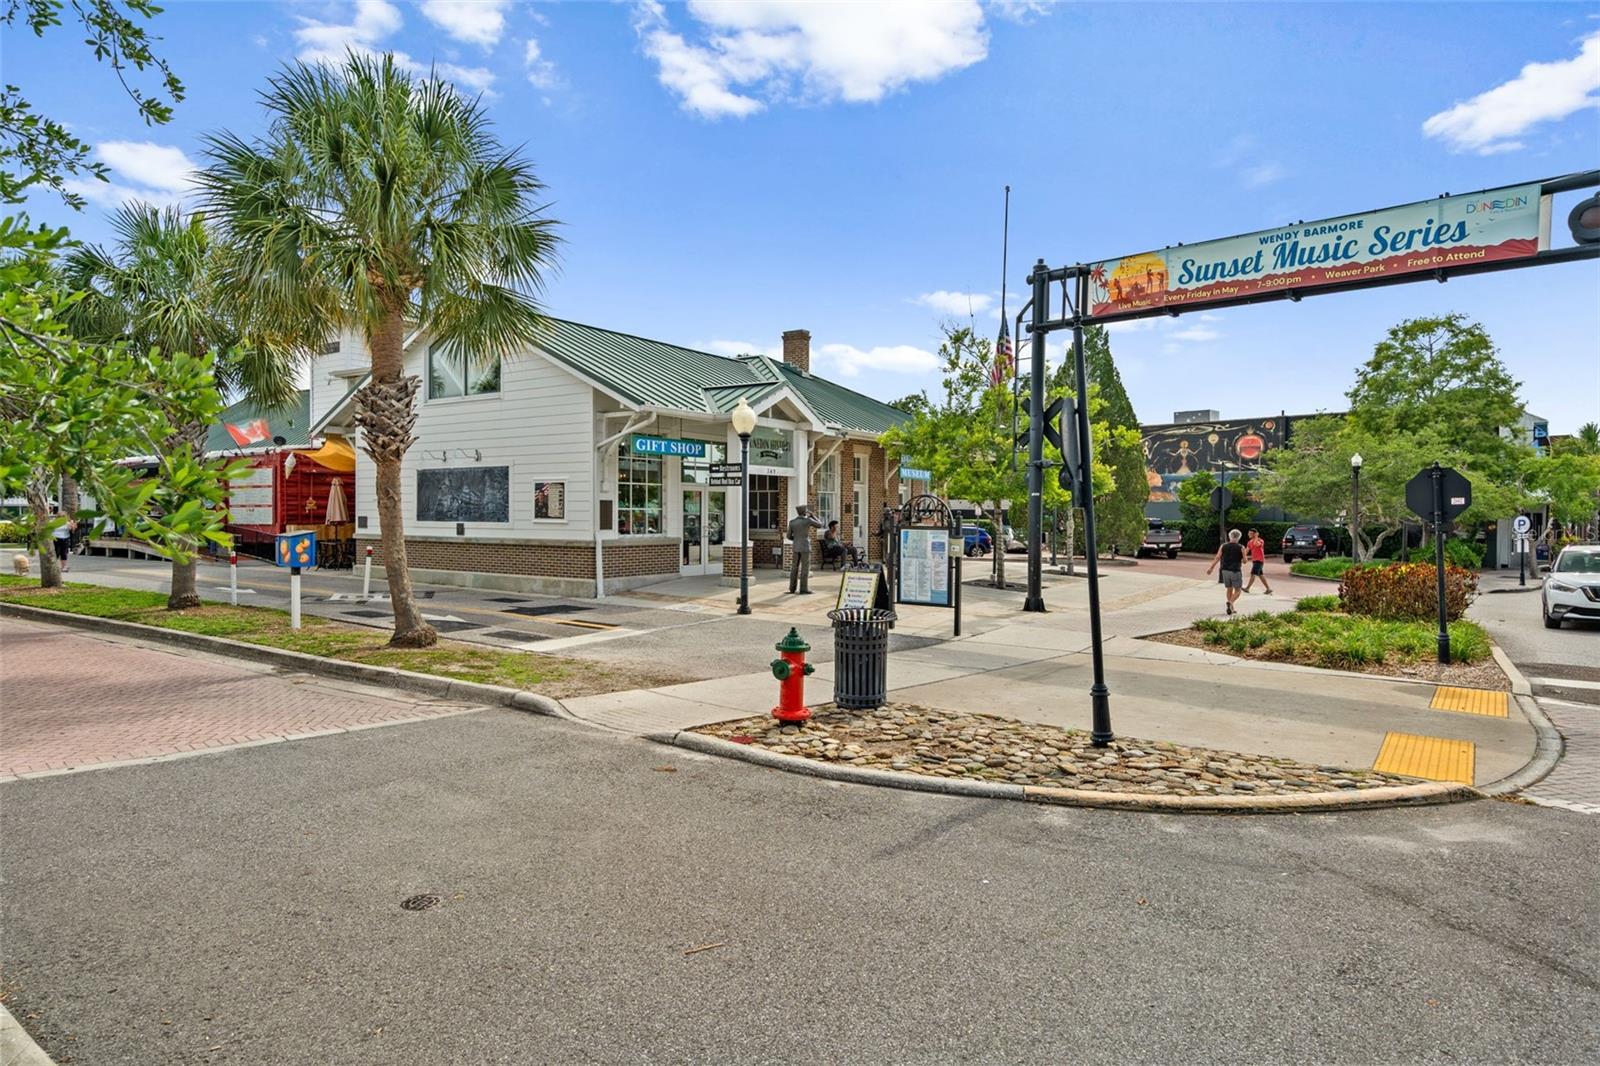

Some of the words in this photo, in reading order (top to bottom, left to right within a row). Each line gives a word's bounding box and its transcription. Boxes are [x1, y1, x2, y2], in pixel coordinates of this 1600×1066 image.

[1466, 196, 1528, 214] DUNEDIN
[1259, 230, 1300, 246] WENDY
[1304, 219, 1364, 237] BARMORE
[1178, 249, 1264, 285] Sunset
[1273, 234, 1359, 270] Music
[1369, 218, 1470, 256] Series
[1118, 302, 1132, 310] Live
[1132, 298, 1152, 308] Music
[1163, 292, 1186, 304] Every
[1187, 288, 1212, 300] Friday
[1213, 288, 1220, 296] in
[1221, 285, 1239, 297] May
[1286, 275, 1302, 287] pm
[1325, 267, 1362, 280] Weaver
[1363, 263, 1386, 275] Park
[1407, 256, 1430, 268] Free
[1432, 254, 1444, 264] to
[1446, 248, 1486, 263] Attend
[635, 438, 668, 452] GIFT
[670, 441, 702, 455] SHOP
[902, 468, 930, 478] MUSEUM
[1518, 519, 1526, 527] P
